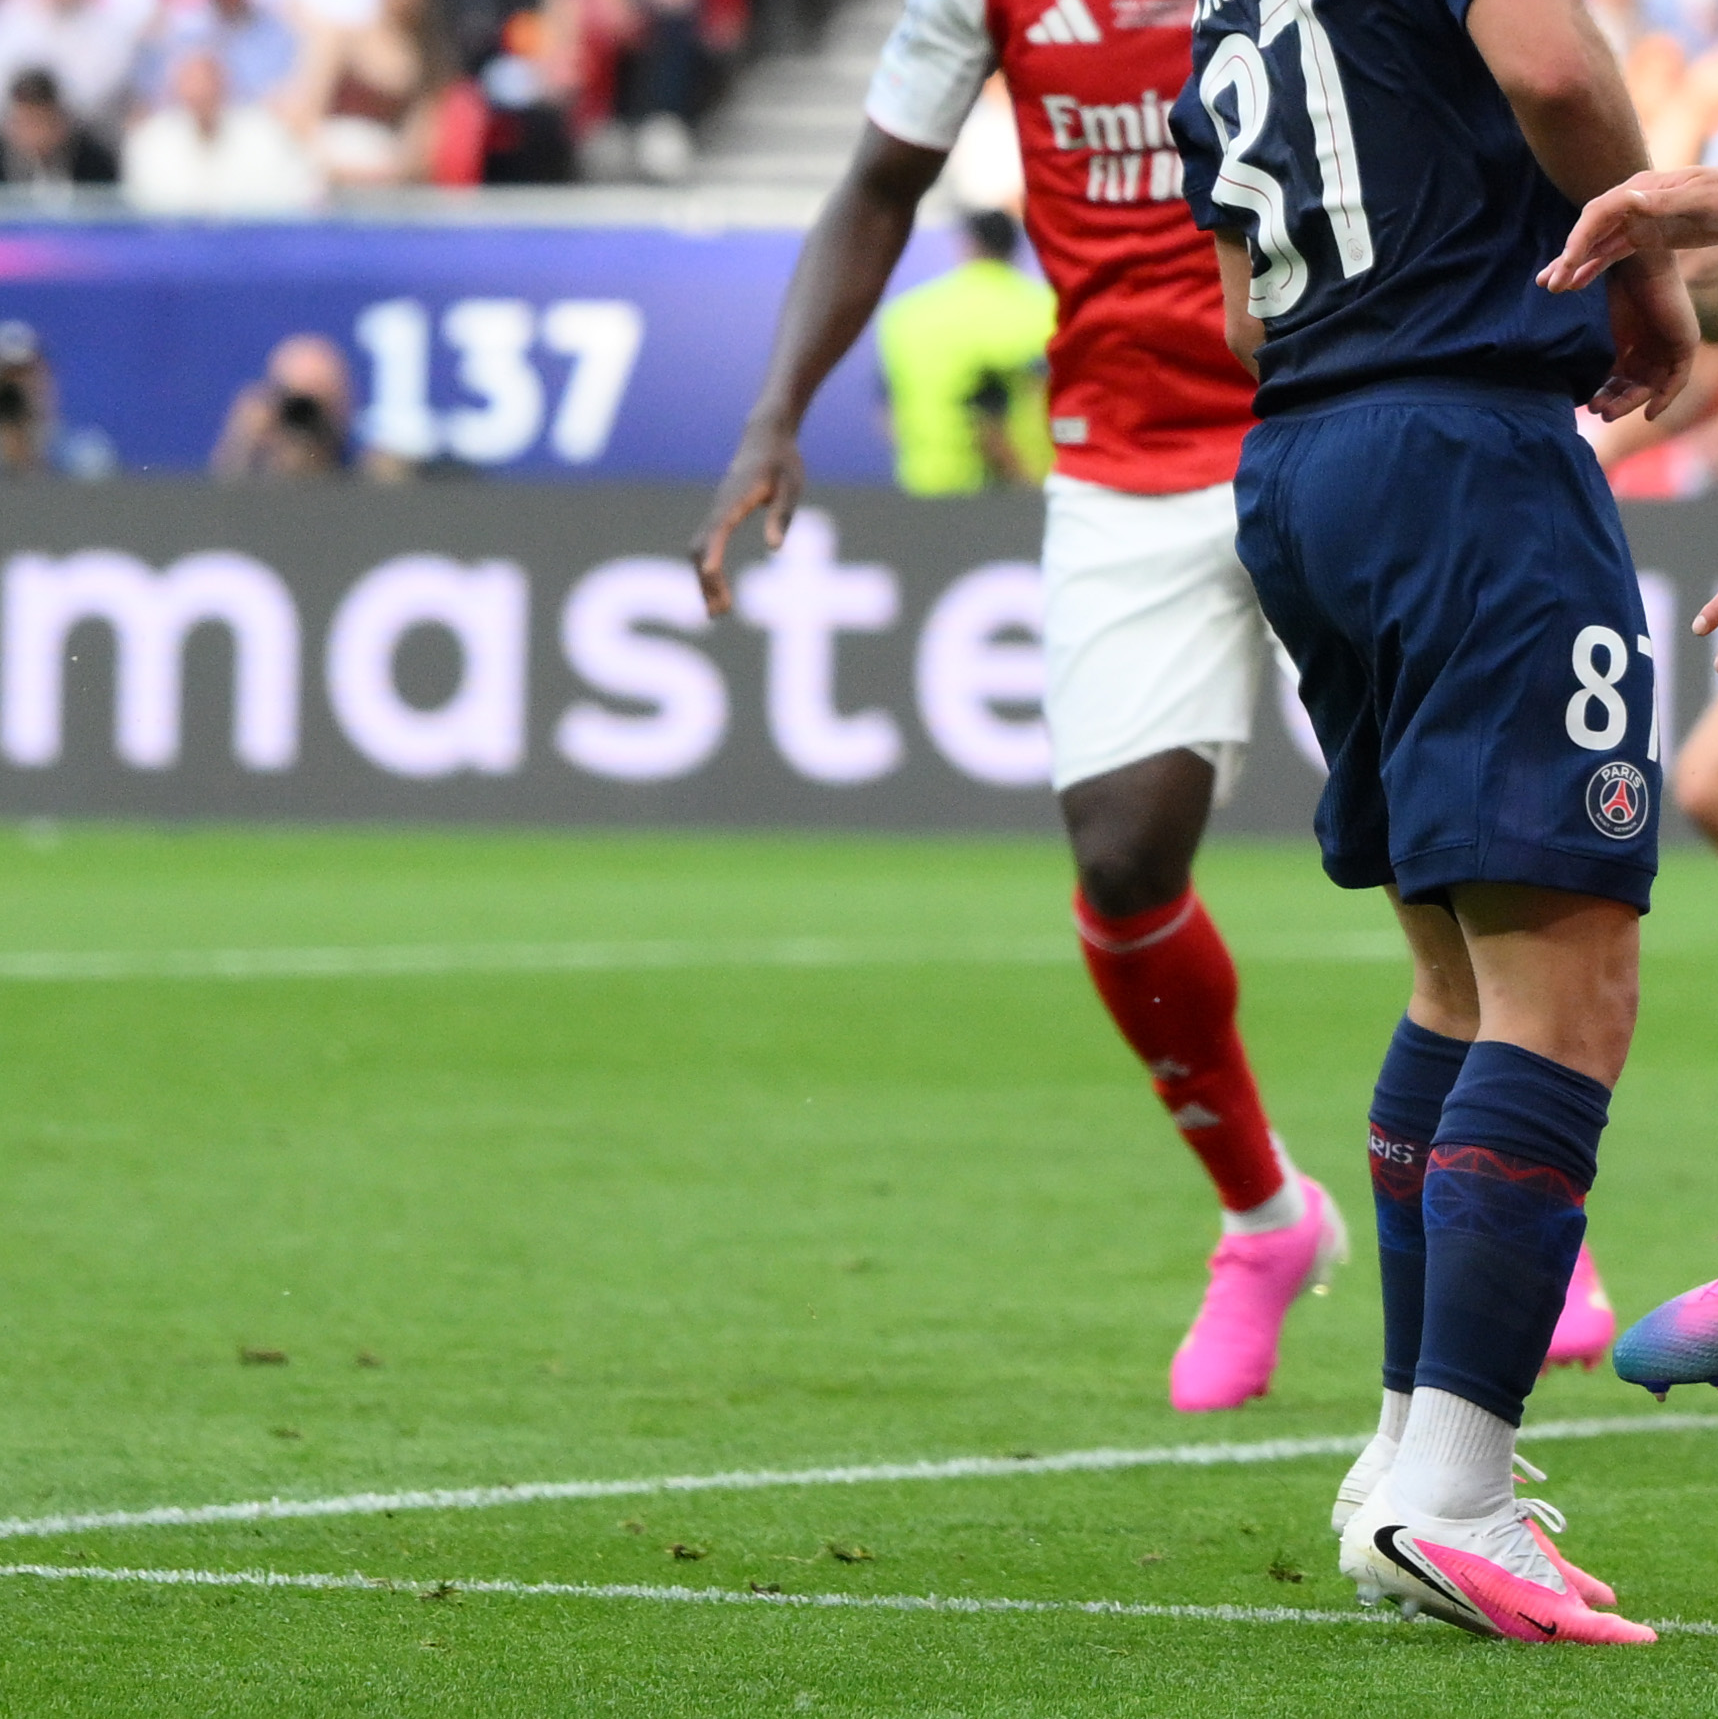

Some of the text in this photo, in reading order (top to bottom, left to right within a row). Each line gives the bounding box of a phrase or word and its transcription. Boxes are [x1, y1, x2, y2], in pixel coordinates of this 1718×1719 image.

[357, 296, 644, 464] 137
[2, 506, 1054, 786] maste
[1600, 766, 1642, 789] PARIS
[1369, 1133, 1416, 1165] RIS
